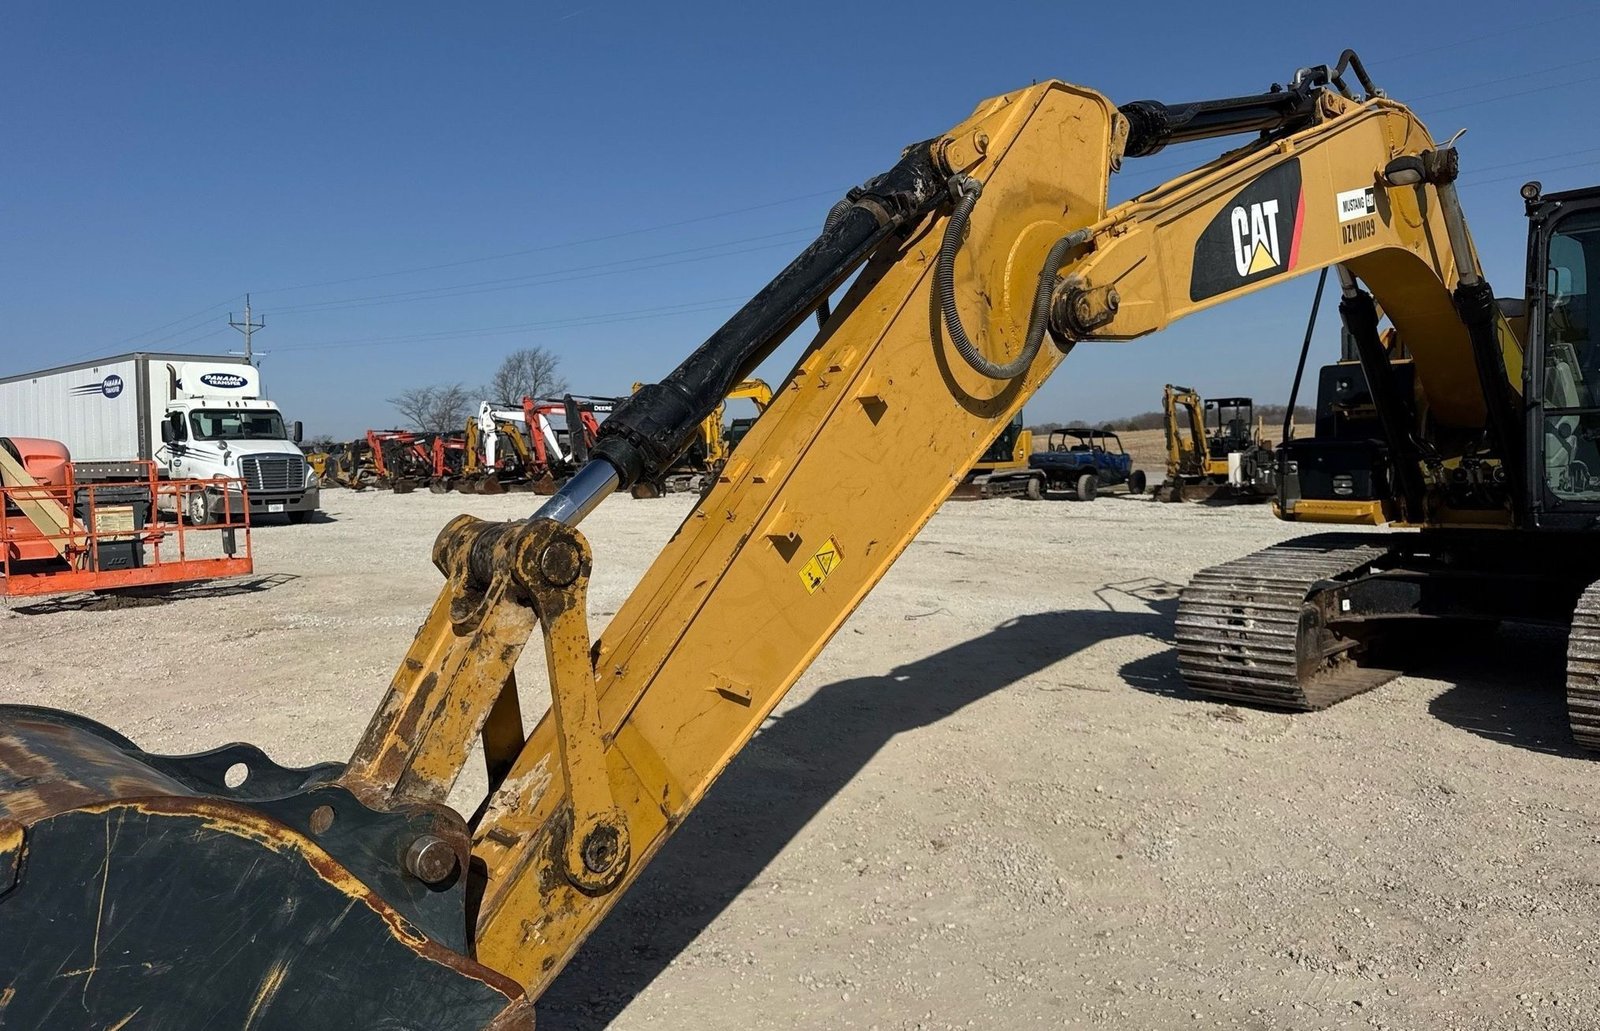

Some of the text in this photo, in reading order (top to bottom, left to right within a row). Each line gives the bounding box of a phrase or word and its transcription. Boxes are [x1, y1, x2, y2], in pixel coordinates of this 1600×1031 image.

[1342, 196, 1365, 213] MUSTANG
[1231, 199, 1281, 277] CAT
[104, 378, 122, 388] PANAMA
[108, 557, 128, 566] JLG
